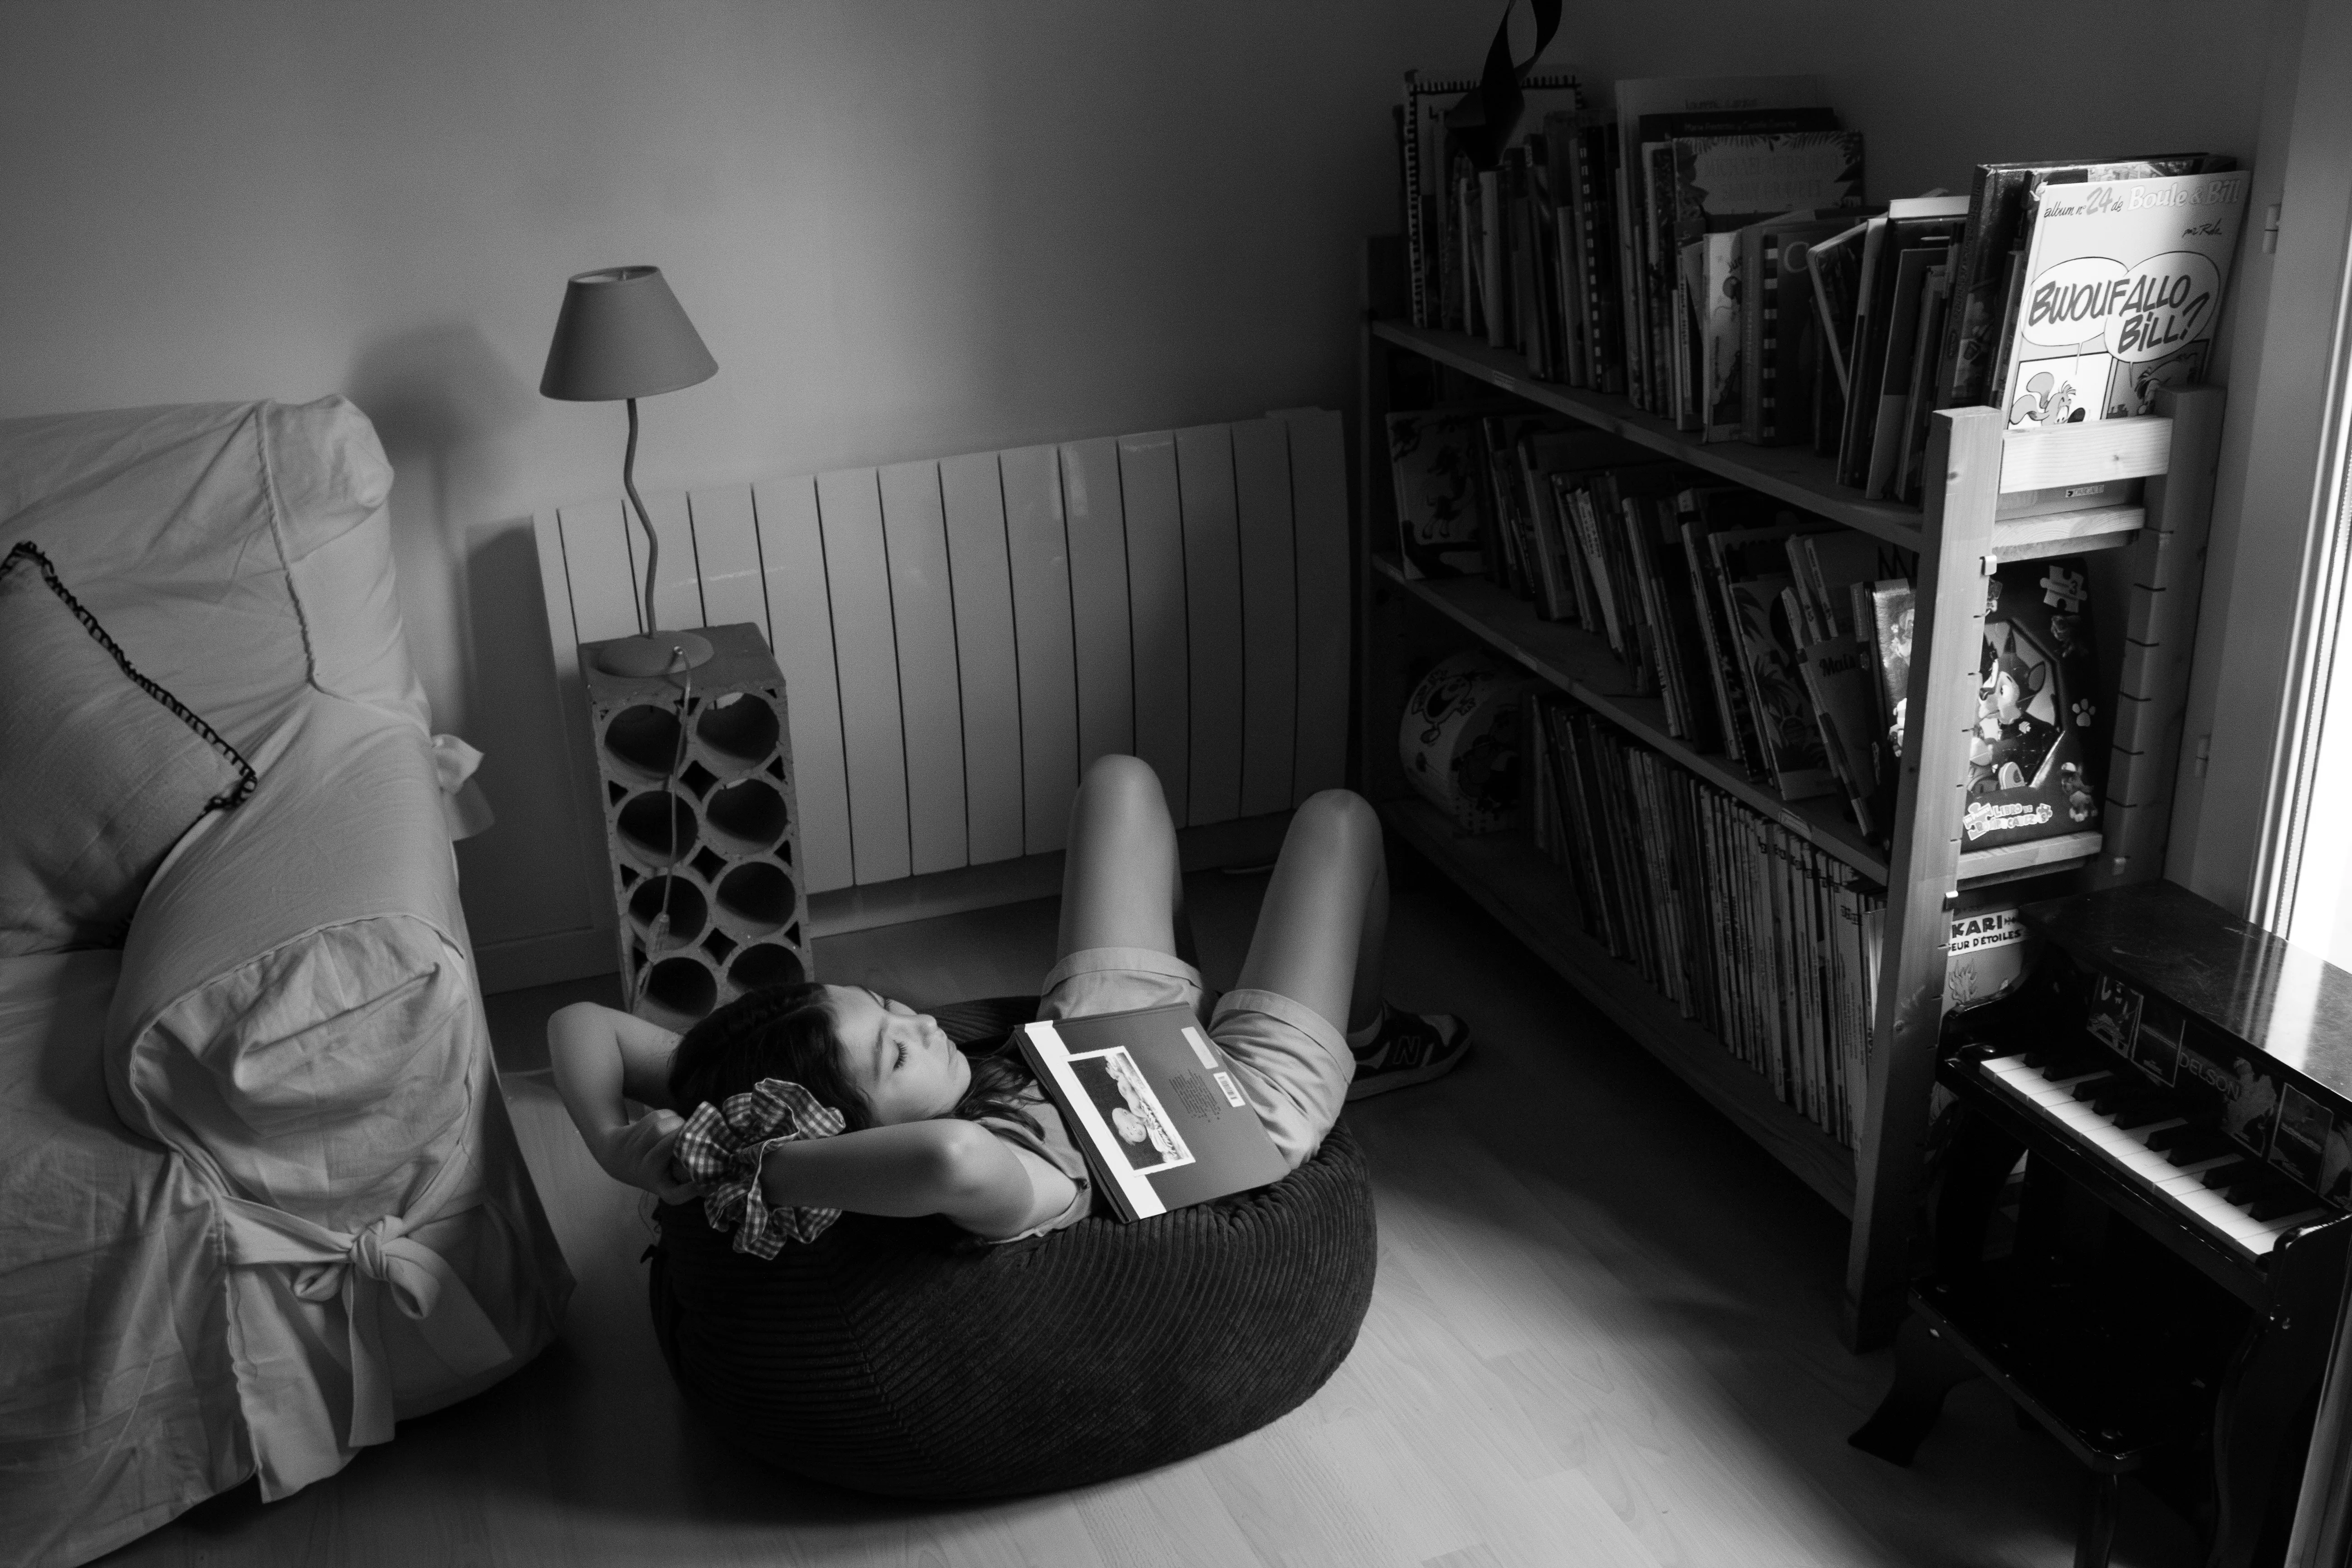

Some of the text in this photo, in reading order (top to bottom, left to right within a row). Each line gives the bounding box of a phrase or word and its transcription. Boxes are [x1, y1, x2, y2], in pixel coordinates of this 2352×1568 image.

[2044, 201, 2075, 218] album
[2087, 186, 2113, 216] 24
[2111, 196, 2123, 212] de
[2127, 182, 2188, 211] Boule
[2190, 186, 2202, 205] &
[2206, 179, 2240, 205] Bill
[1975, 812, 2048, 832] ROMPCAEZS
[1993, 804, 2023, 818] LIBRO
[1952, 915, 2002, 939] KARI
[1951, 940, 1970, 952] EUR
[1393, 1034, 1421, 1065] N
[2179, 1051, 2243, 1101] DELSON
